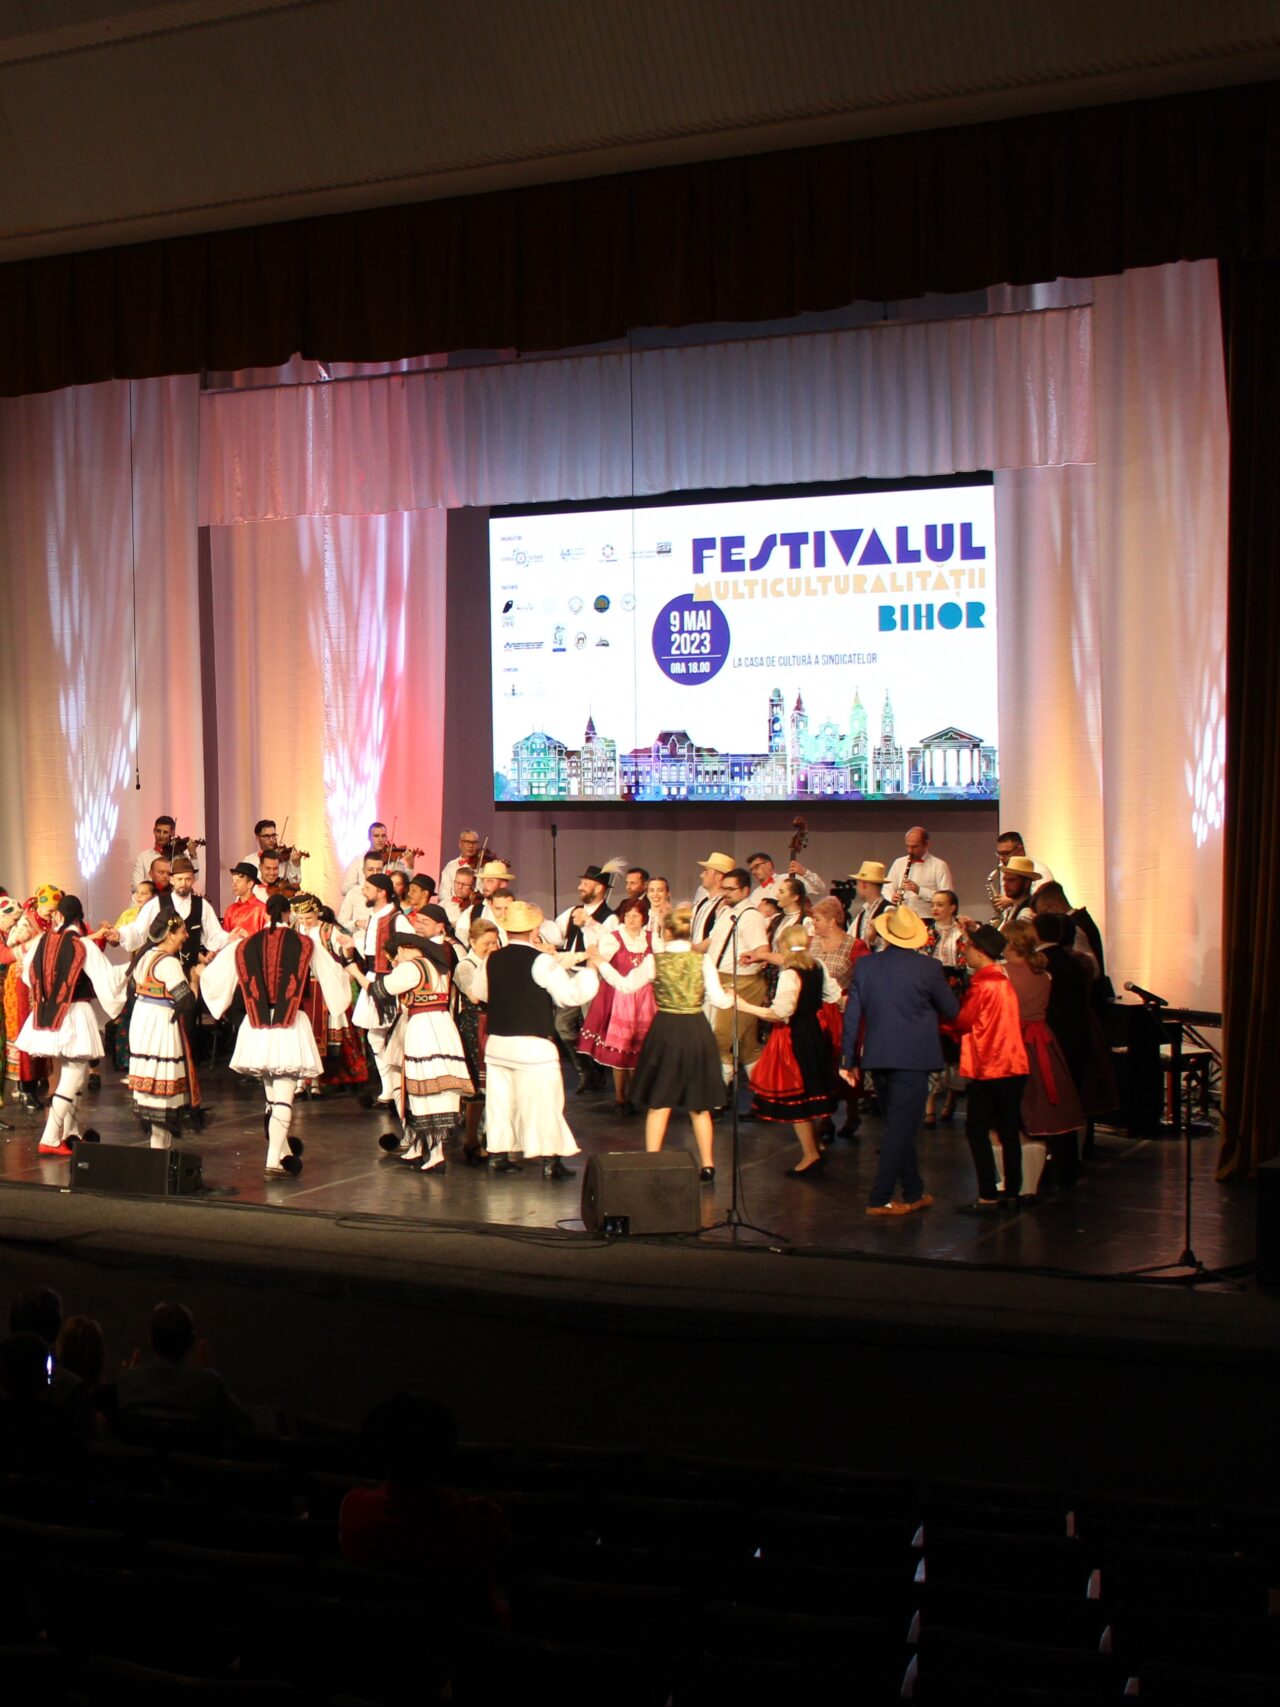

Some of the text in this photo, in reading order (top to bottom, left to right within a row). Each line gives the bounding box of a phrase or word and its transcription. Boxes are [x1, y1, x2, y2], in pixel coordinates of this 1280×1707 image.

[692, 522, 986, 574] FESTIVALUL
[669, 609, 711, 632] 9 MAI
[878, 601, 986, 632] BIHOR
[670, 632, 711, 655] 2023
[670, 662, 686, 674] ORA
[732, 656, 743, 668] LA
[744, 656, 764, 668] CASA
[765, 655, 776, 667] DE
[814, 654, 820, 666] A
[821, 652, 878, 666] SINDICATELOR
